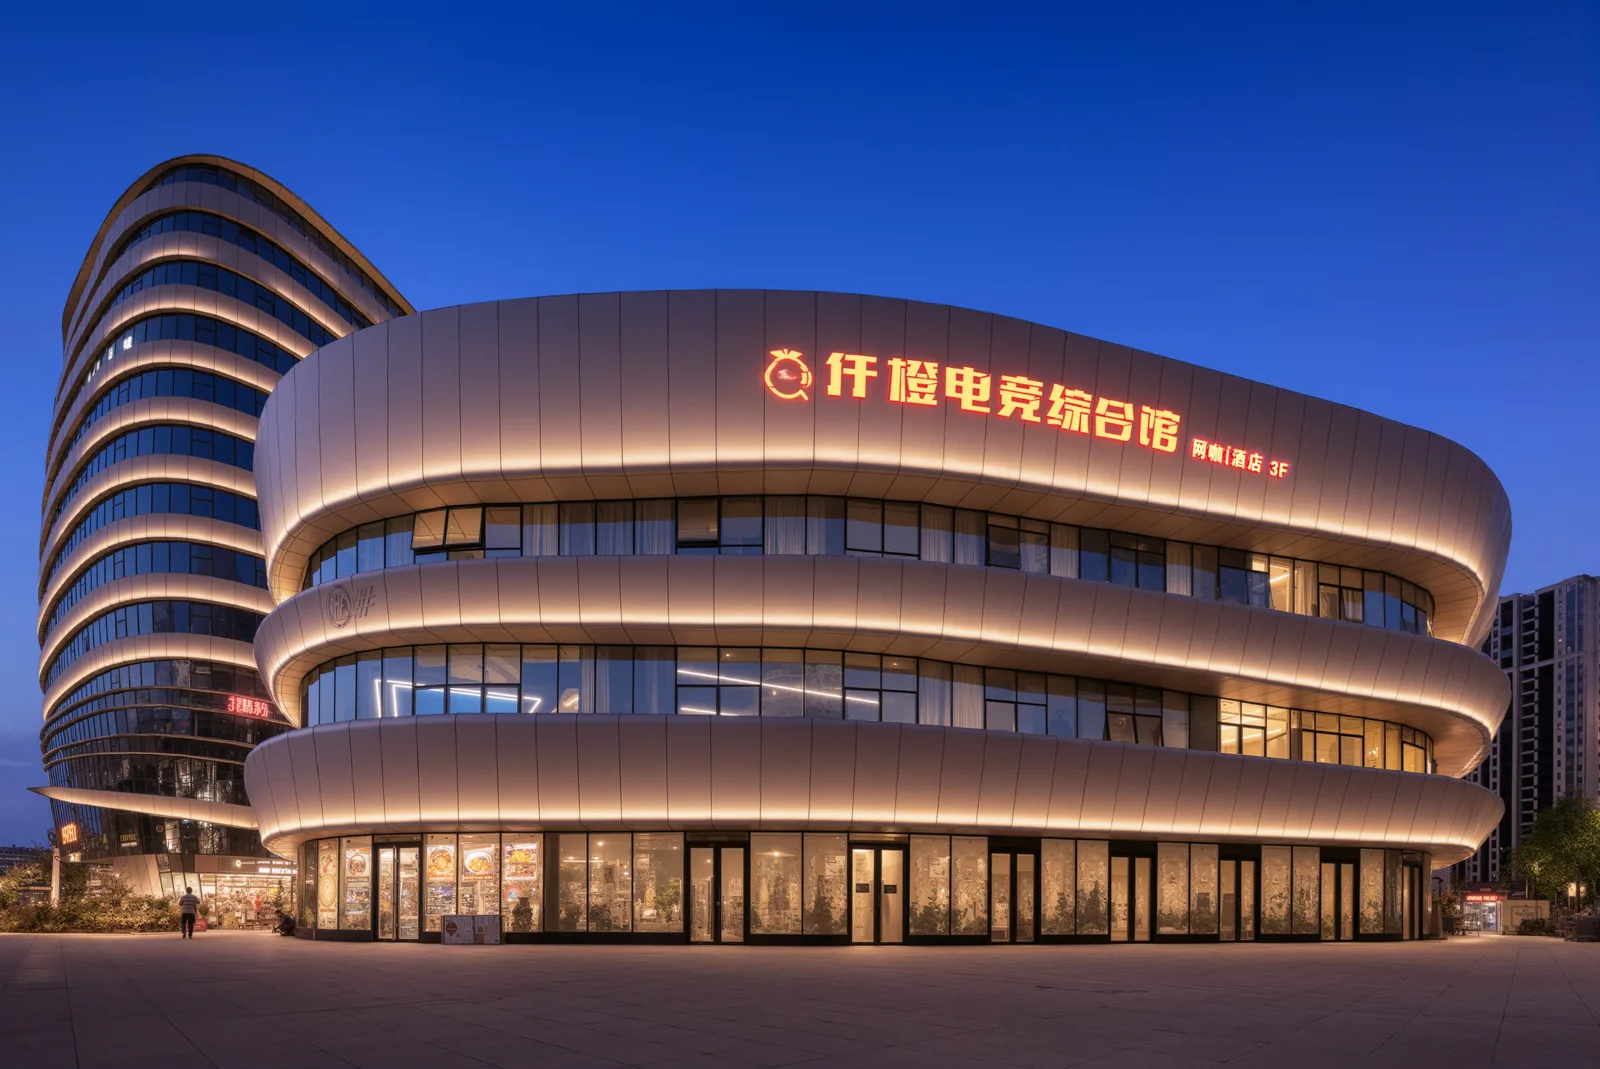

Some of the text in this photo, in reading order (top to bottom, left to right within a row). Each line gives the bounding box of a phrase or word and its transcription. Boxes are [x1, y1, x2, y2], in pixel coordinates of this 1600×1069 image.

[826, 352, 1181, 453] 仟橙电竞综合馆
[1269, 460, 1289, 478] 3F
